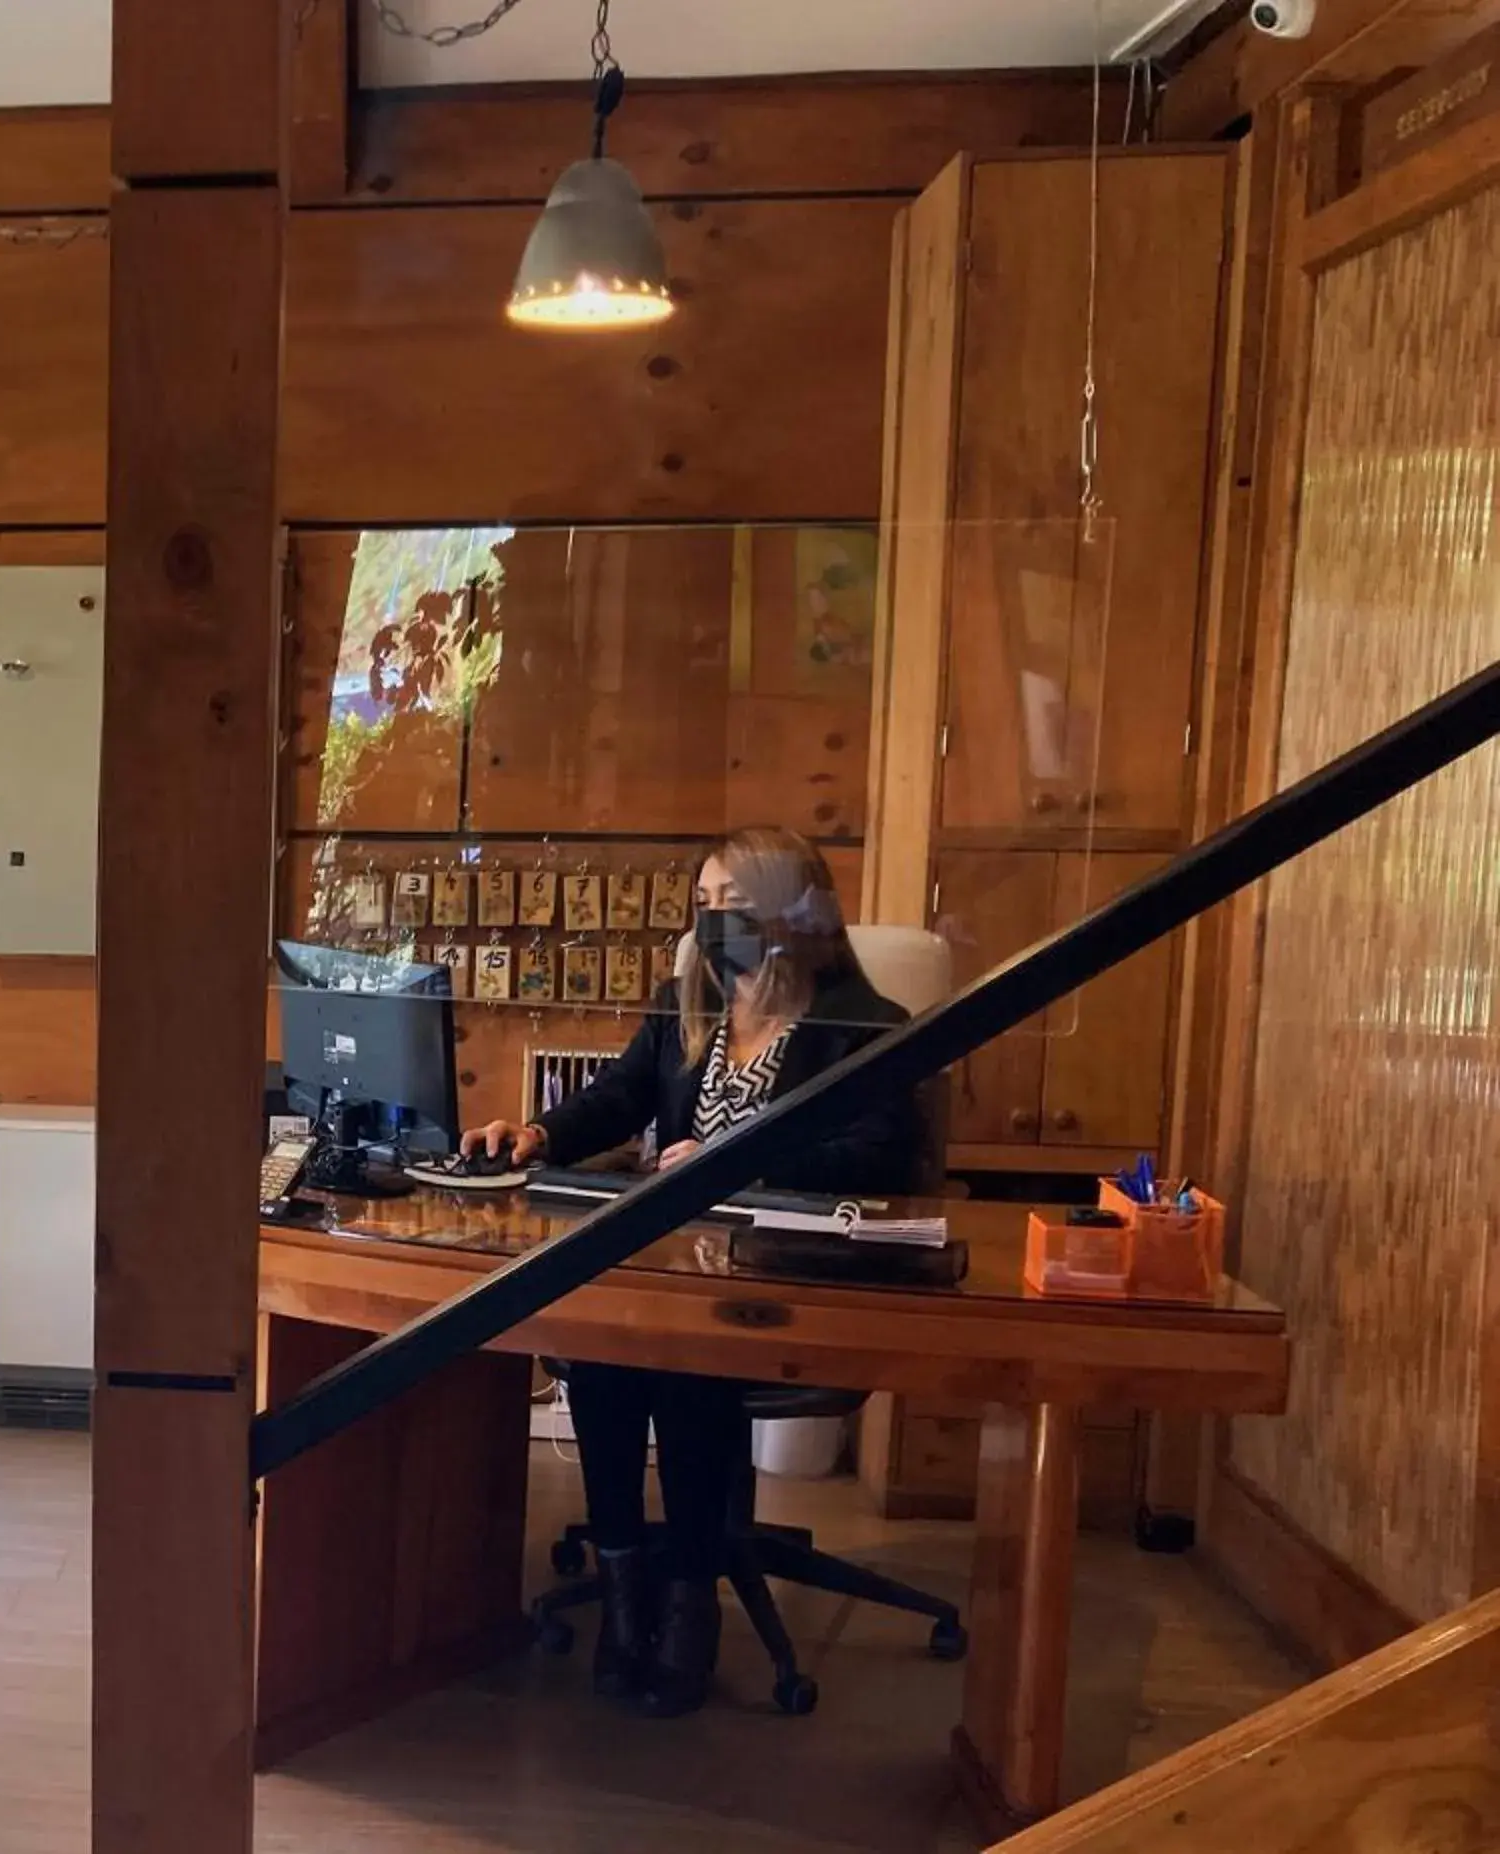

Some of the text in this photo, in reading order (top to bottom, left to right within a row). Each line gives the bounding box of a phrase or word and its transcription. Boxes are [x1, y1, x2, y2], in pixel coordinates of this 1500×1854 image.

[408, 877, 421, 892] 3
[490, 873, 503, 891] 5
[533, 873, 545, 892] 6
[577, 878, 590, 897] 7
[667, 872, 678, 891] 9
[441, 948, 460, 966] 14
[484, 951, 507, 968] 15
[528, 950, 548, 966] 16
[580, 951, 598, 967] 17
[620, 950, 638, 967] 18
